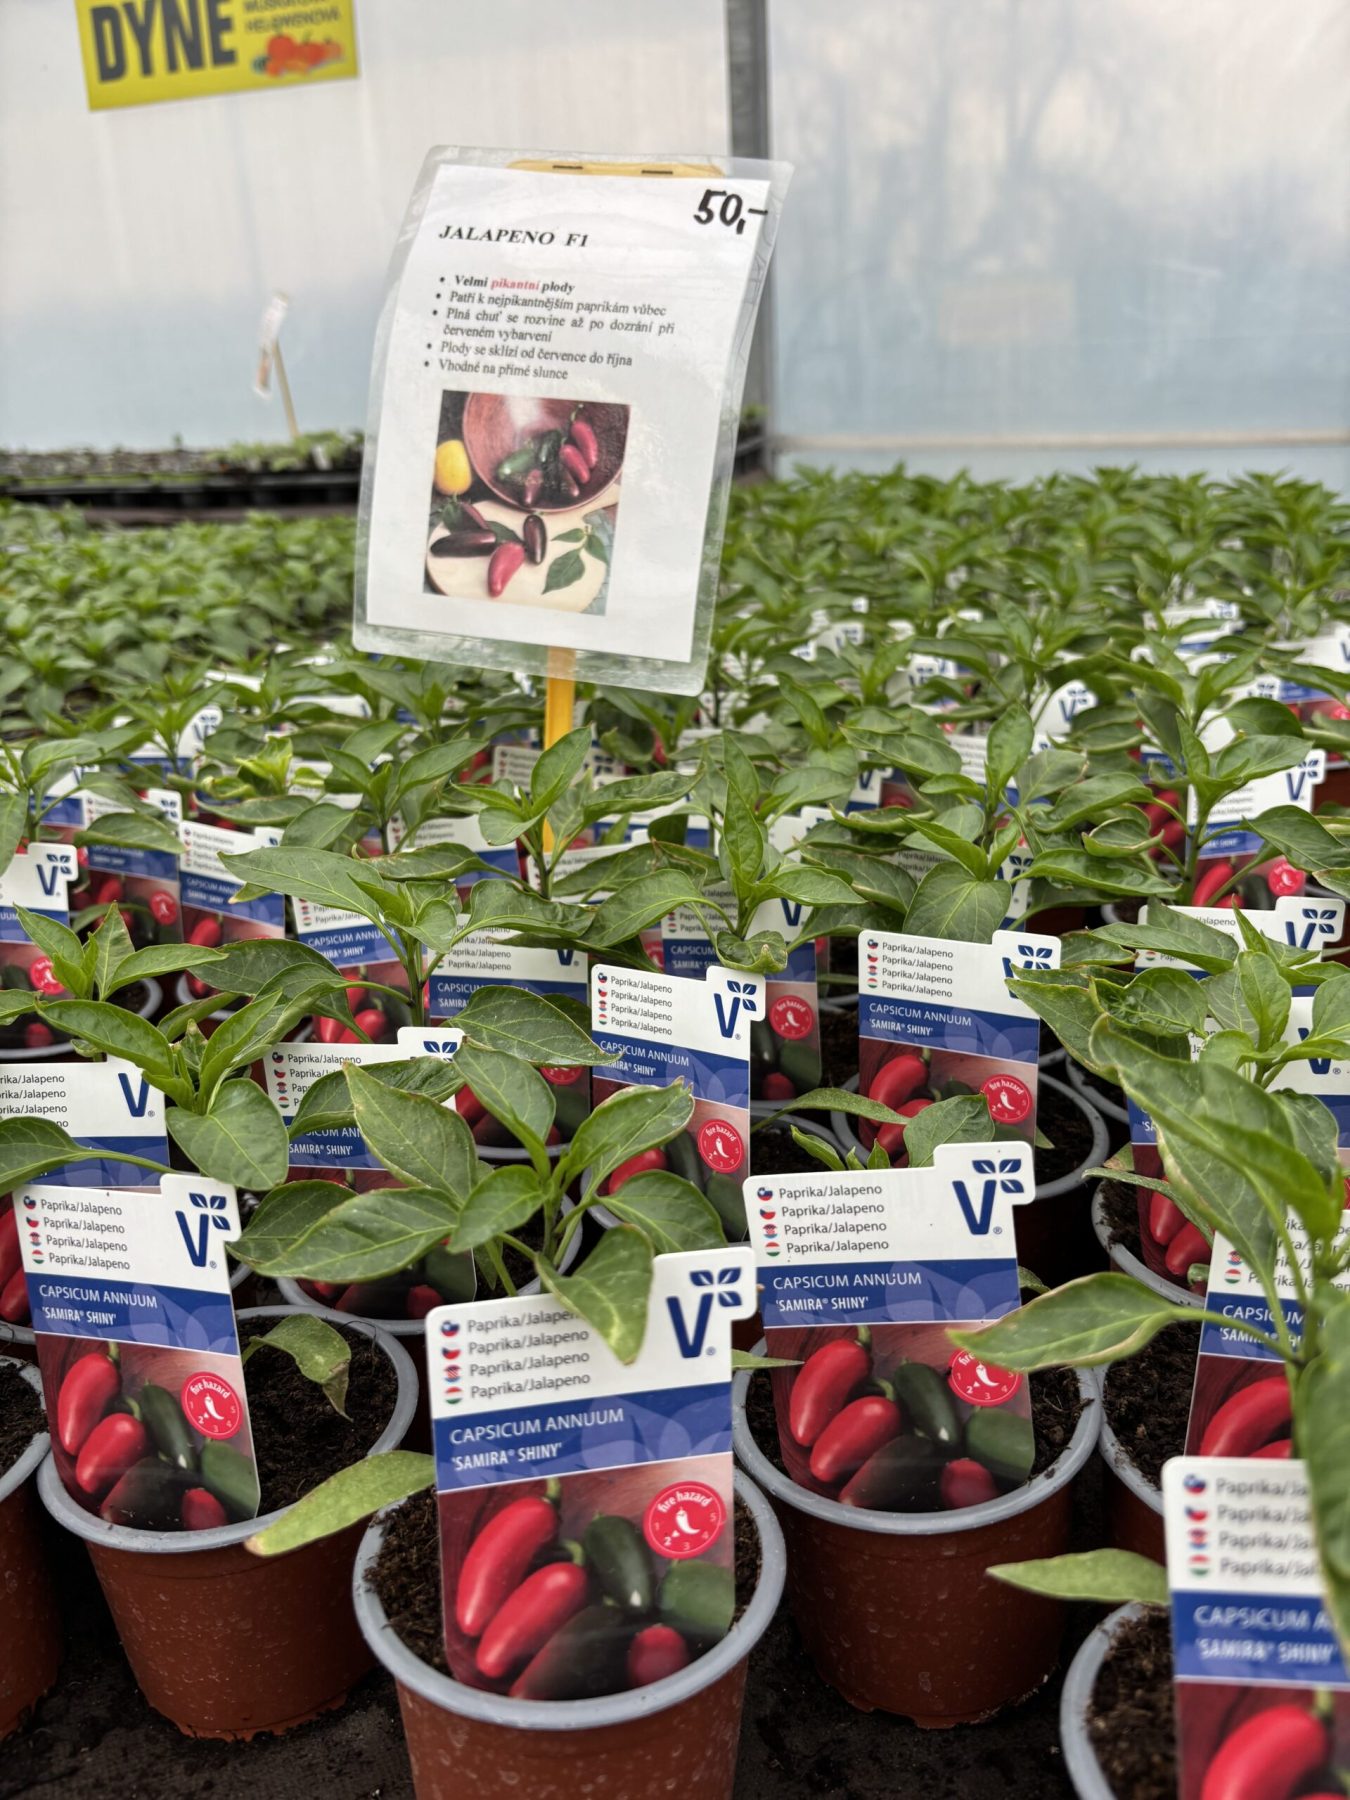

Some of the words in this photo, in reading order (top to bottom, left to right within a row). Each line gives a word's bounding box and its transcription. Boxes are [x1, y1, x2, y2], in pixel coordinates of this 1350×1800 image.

[694, 188, 769, 235] 50,-
[439, 225, 555, 245] JALAPENO
[565, 233, 589, 248] F1
[455, 275, 488, 288] Velmi
[490, 278, 540, 291] pikantní
[541, 281, 575, 295] plody
[450, 291, 476, 303] Patří
[478, 294, 485, 304] k
[487, 294, 574, 311] nejpikantnějším
[575, 300, 629, 315] paprikám
[632, 304, 667, 317] vůbec
[446, 307, 471, 321] Plná
[475, 310, 502, 322] chuť
[507, 314, 519, 323] se
[524, 314, 565, 327] rozvine
[571, 317, 584, 329] až
[590, 321, 604, 331] po
[609, 318, 653, 333] dozrání
[658, 322, 675, 336] při
[443, 325, 495, 339] červeném
[498, 328, 552, 342] vybarvení
[441, 341, 472, 357] Plody
[474, 345, 486, 356] se
[488, 343, 518, 357] sklízí
[520, 345, 535, 359] od
[537, 349, 586, 364] července
[589, 351, 604, 364] do
[606, 352, 633, 368] října
[438, 358, 480, 373] Vhodné
[482, 364, 496, 374] na
[498, 362, 530, 377] přímé
[532, 366, 569, 380] slunce
[882, 942, 954, 959] Paprika/Jalapeno
[448, 959, 512, 972] Paprika/Jalapeno
[882, 954, 954, 972] Paprika/Jalapeno
[610, 975, 673, 994] Paprika/Jalapeno
[882, 967, 953, 985] Paprika/Jalapeno
[610, 989, 673, 1008] Paprika/Jalapeno
[882, 980, 953, 998] Paprika/Jalapeno
[610, 1003, 673, 1022] Paprika/Jalapeno
[869, 1002, 922, 1019] CAPSICUM
[923, 1010, 972, 1027] ANNUUM
[610, 1017, 673, 1036] Paprika/Jalapeno
[600, 1039, 647, 1058] CAPSICUM
[647, 1049, 690, 1067] ANNUUM
[778, 1183, 883, 1200] Paprika/Jalapeno
[40, 1197, 123, 1217] Paprika/Jalapeno
[781, 1202, 885, 1219] Paprika/Jalapeno
[952, 1179, 997, 1236] V
[42, 1215, 126, 1235] Paprika/Jalapeno
[783, 1220, 887, 1237] Paprika/Jalapeno
[45, 1233, 128, 1253] Paprika/Jalapeno
[175, 1210, 210, 1268] V
[786, 1239, 889, 1256] Paprika/Jalapeno
[48, 1252, 131, 1271] Paprika/Jalapeno
[772, 1274, 850, 1291] CAPSICUM
[853, 1271, 922, 1287] ANNUUM
[38, 1284, 100, 1304] CAPSICUM
[103, 1290, 158, 1309] ANNUUM
[665, 1292, 714, 1359] V
[467, 1329, 590, 1357] Paprika/Jalapeno
[469, 1351, 590, 1378] Paprika/Jalapeno
[470, 1372, 591, 1399] Paprika/Jalapeno
[449, 1419, 542, 1445] CAPSICUM
[545, 1407, 624, 1433] ANNUUM
[675, 1490, 713, 1508] hazard
[1193, 1604, 1311, 1631] CAPSICUM
